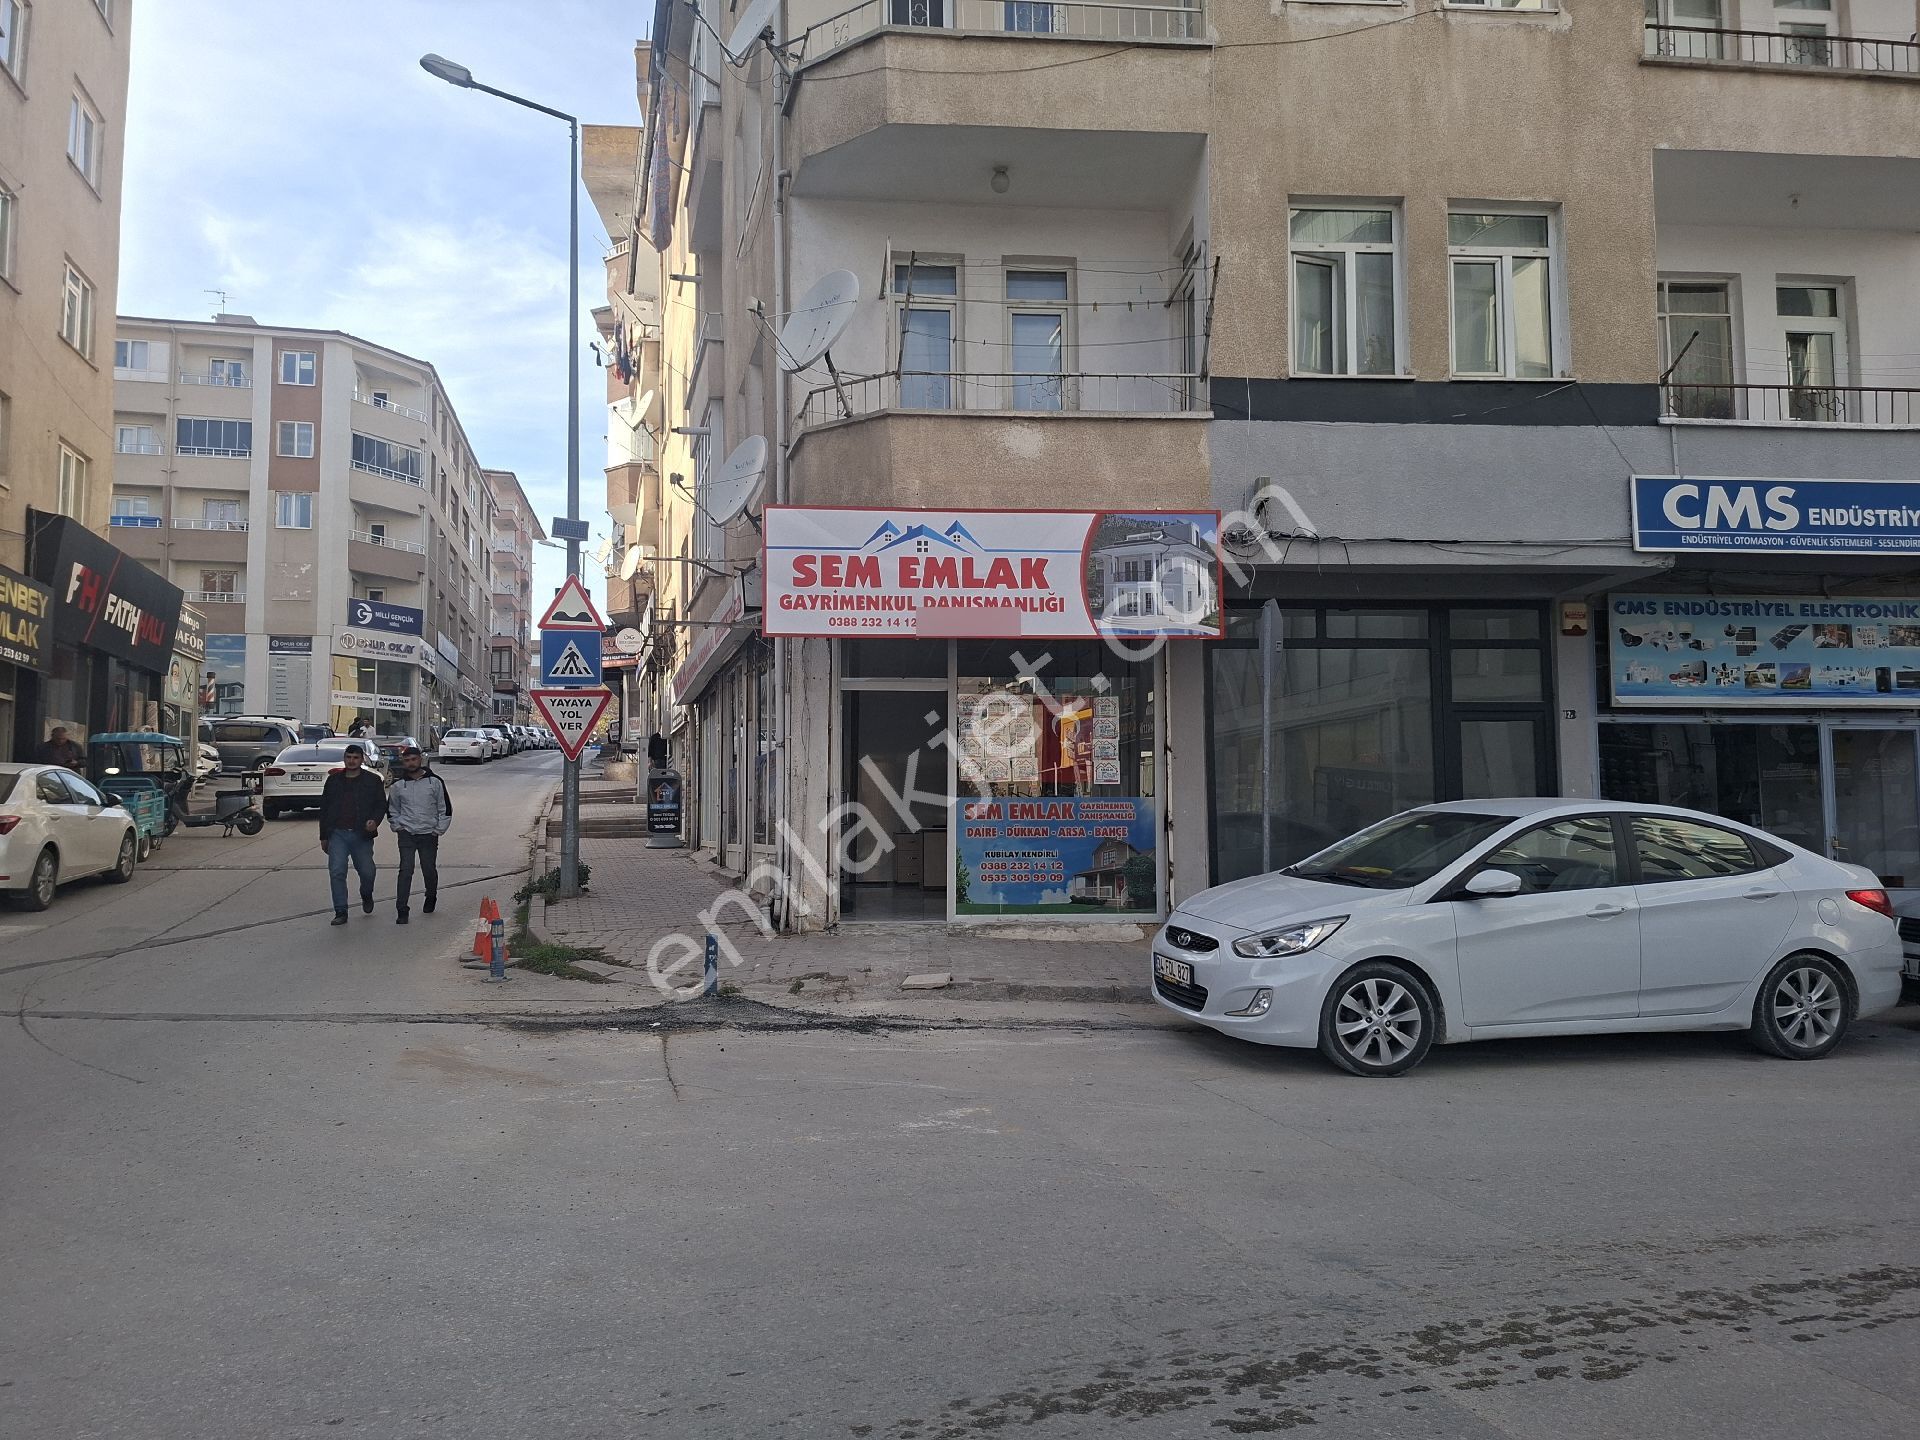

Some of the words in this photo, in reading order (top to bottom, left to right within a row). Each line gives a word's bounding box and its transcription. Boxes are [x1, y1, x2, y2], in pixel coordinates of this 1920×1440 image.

[1662, 483, 1800, 531] CMS
[1681, 534, 1733, 545] ENDÜSTRİYEL
[1734, 536, 1783, 546] OTOMASYON
[1790, 536, 1829, 547] GÜVENLİK
[1829, 537, 1873, 547] SİSTEMLERİ
[792, 554, 882, 588] SEM
[898, 556, 1050, 590] EMLAK
[779, 589, 917, 612] GAYRİMENKUL
[1613, 601, 1657, 615] CMS
[1664, 600, 1794, 617] ENDÜSTRİYEL
[1800, 602, 1919, 619] ELEKTRONİK
[828, 617, 858, 627] 0388
[861, 617, 882, 627] 232
[886, 618, 900, 627] 14
[904, 618, 916, 627] 12
[549, 698, 593, 707] YAYAYA
[560, 710, 583, 719] YOL
[560, 722, 583, 730] VER
[1079, 801, 1134, 810] GAYRİMENKUL
[964, 803, 1003, 820] SEM
[1008, 802, 1075, 821] EMLAK
[966, 825, 998, 837] DAİRE
[1006, 824, 1050, 837] DÜKKAN
[1057, 826, 1086, 837] ARSA
[1093, 826, 1128, 840] BAHÇE
[985, 850, 1019, 858] KUBİLAY
[1021, 849, 1058, 858] KENDİRLİ
[980, 862, 1007, 870] 0388
[1010, 862, 1030, 870] 232
[1033, 862, 1047, 870] 14
[1050, 862, 1063, 870] 12
[980, 873, 1007, 882] 0535
[1010, 873, 1030, 882] 305
[1033, 873, 1047, 882] 99
[1049, 873, 1063, 882] 09
